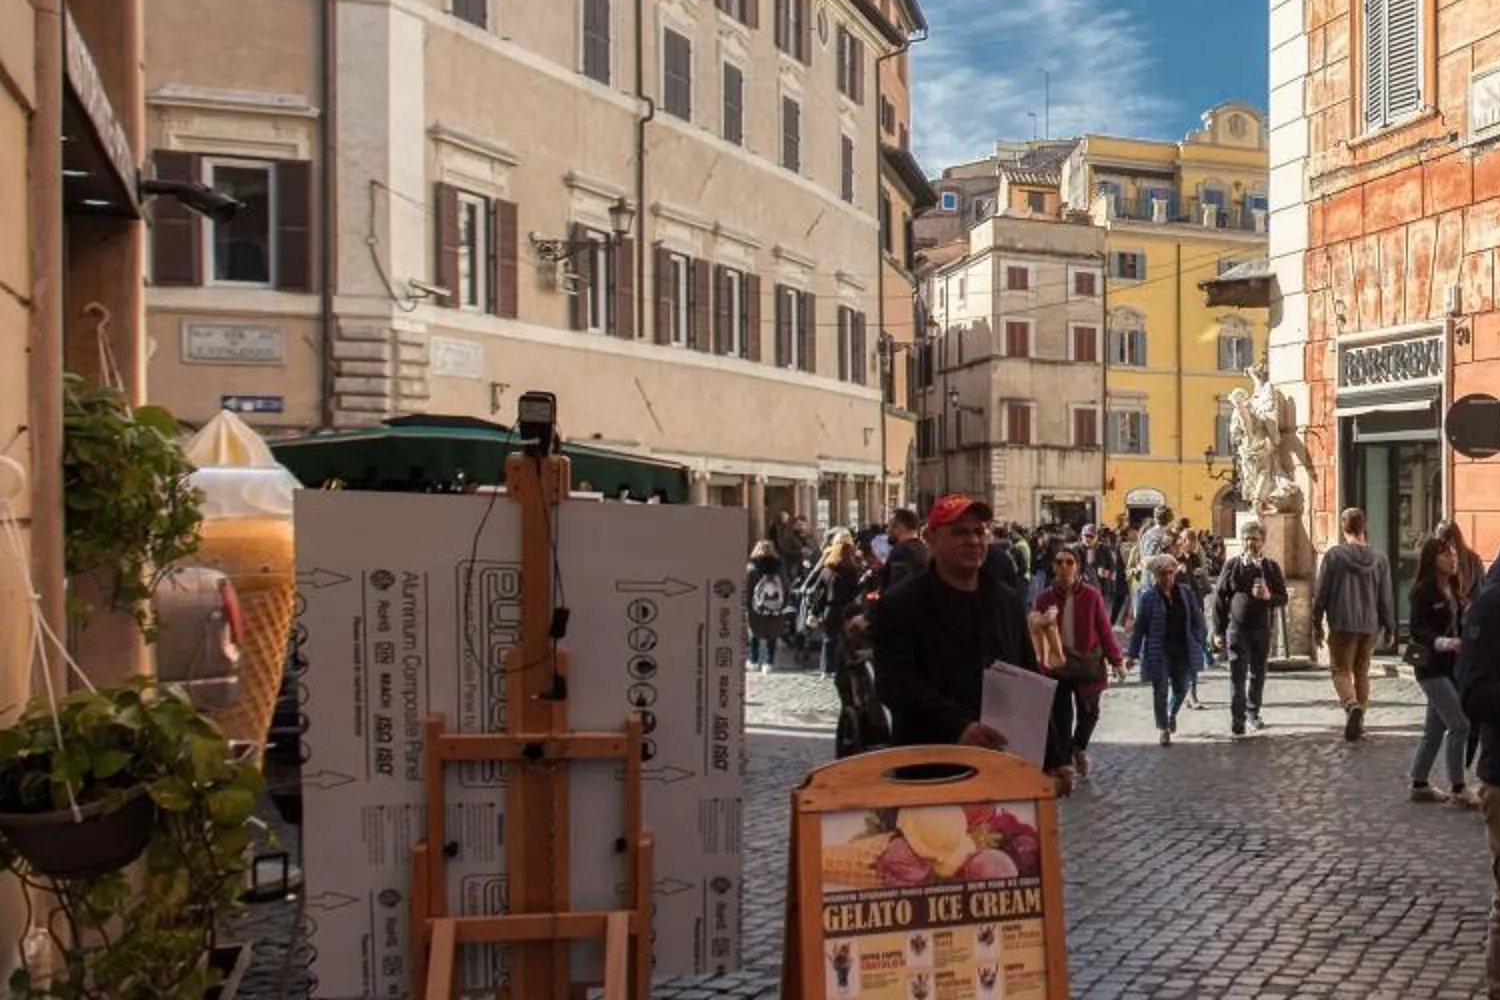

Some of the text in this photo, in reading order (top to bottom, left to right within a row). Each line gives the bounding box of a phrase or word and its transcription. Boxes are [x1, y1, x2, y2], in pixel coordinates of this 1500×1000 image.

[401, 571, 425, 781] Aluminium Composite Panel
[718, 675, 729, 708] REACH
[823, 899, 913, 932] GELATO
[927, 895, 962, 923] ICE
[970, 888, 1042, 918] CREAM
